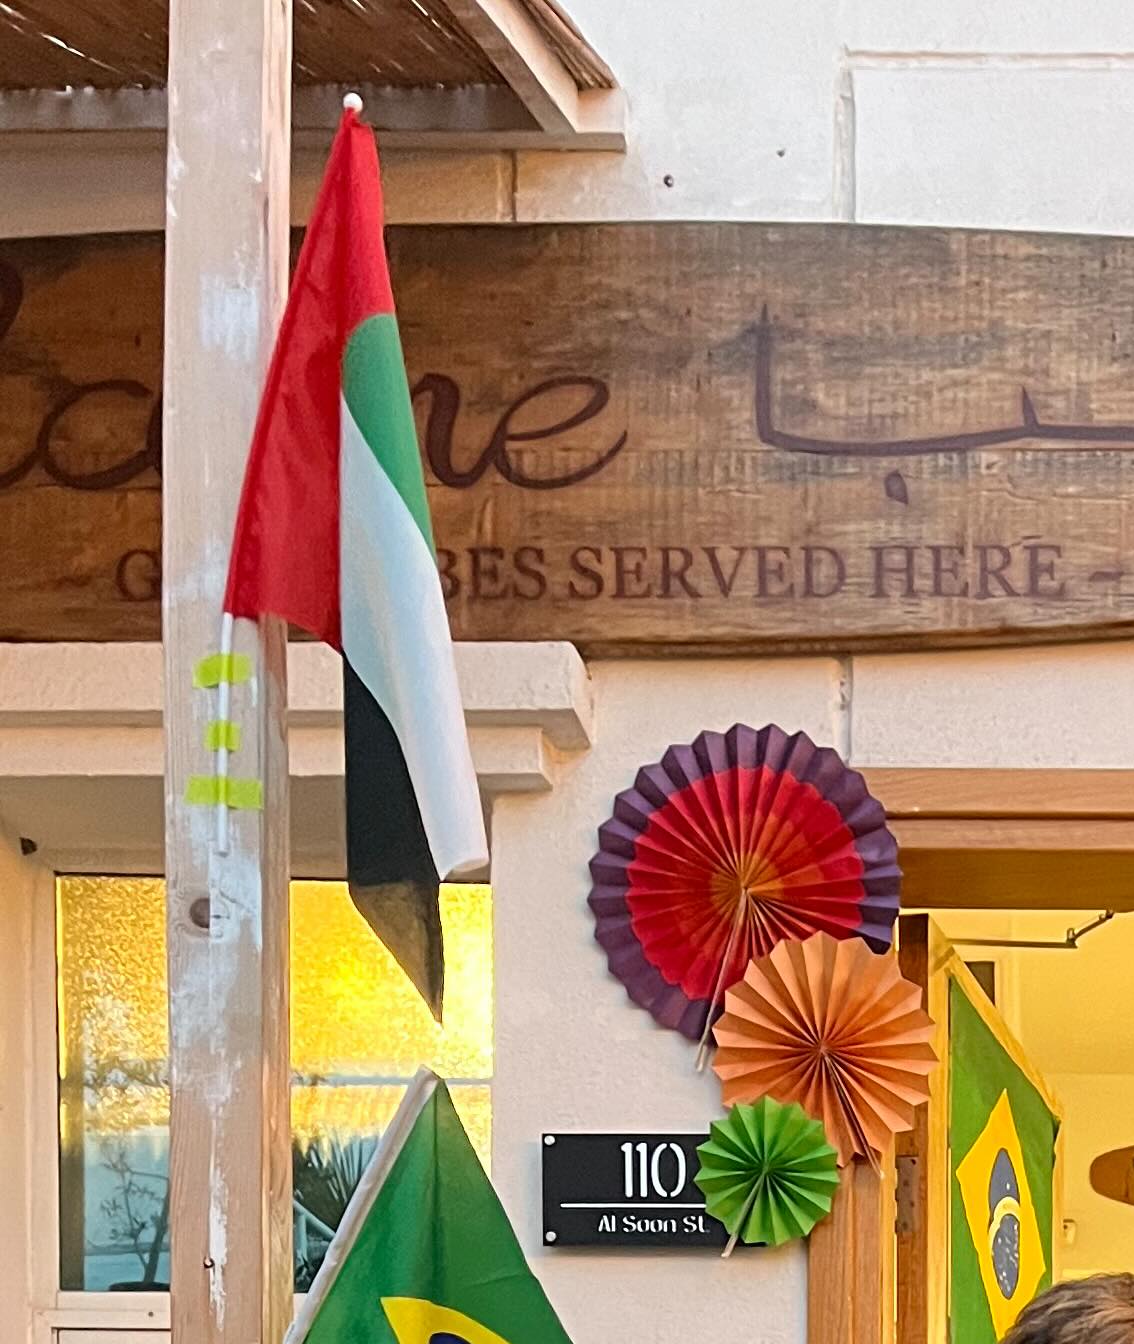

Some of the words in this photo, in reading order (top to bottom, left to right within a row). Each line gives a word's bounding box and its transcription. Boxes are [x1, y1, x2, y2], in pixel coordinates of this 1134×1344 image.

[568, 545, 848, 601] SERVED
[873, 543, 1067, 599] HERE
[620, 1142, 687, 1198] 110
[598, 1215, 616, 1233] Al
[622, 1215, 677, 1233] Soon
